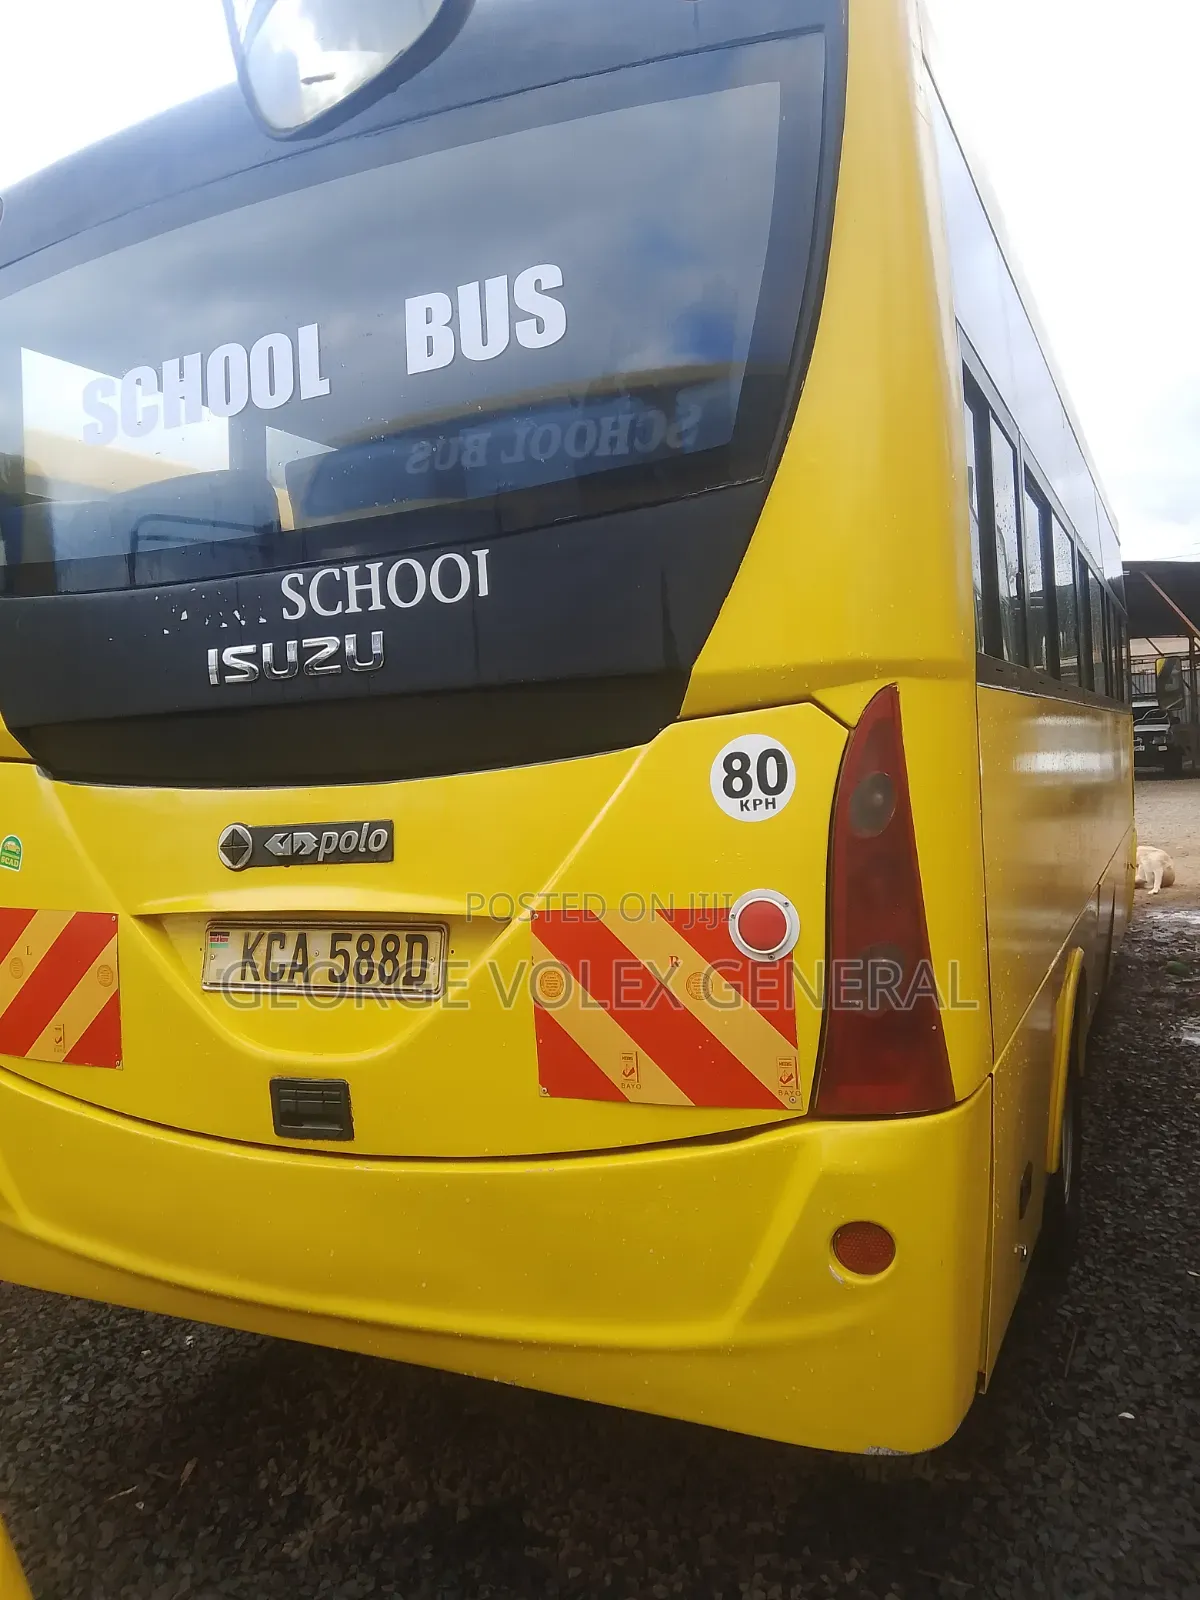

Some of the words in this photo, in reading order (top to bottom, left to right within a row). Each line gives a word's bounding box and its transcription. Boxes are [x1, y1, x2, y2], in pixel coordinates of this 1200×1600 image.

[82, 323, 330, 446] SCHOOL
[405, 263, 567, 375] BUS
[207, 630, 385, 686] ISUZU
[722, 748, 788, 799] 80
[740, 797, 776, 811] KPH
[240, 930, 310, 983] KCA
[328, 932, 429, 986] 588D
